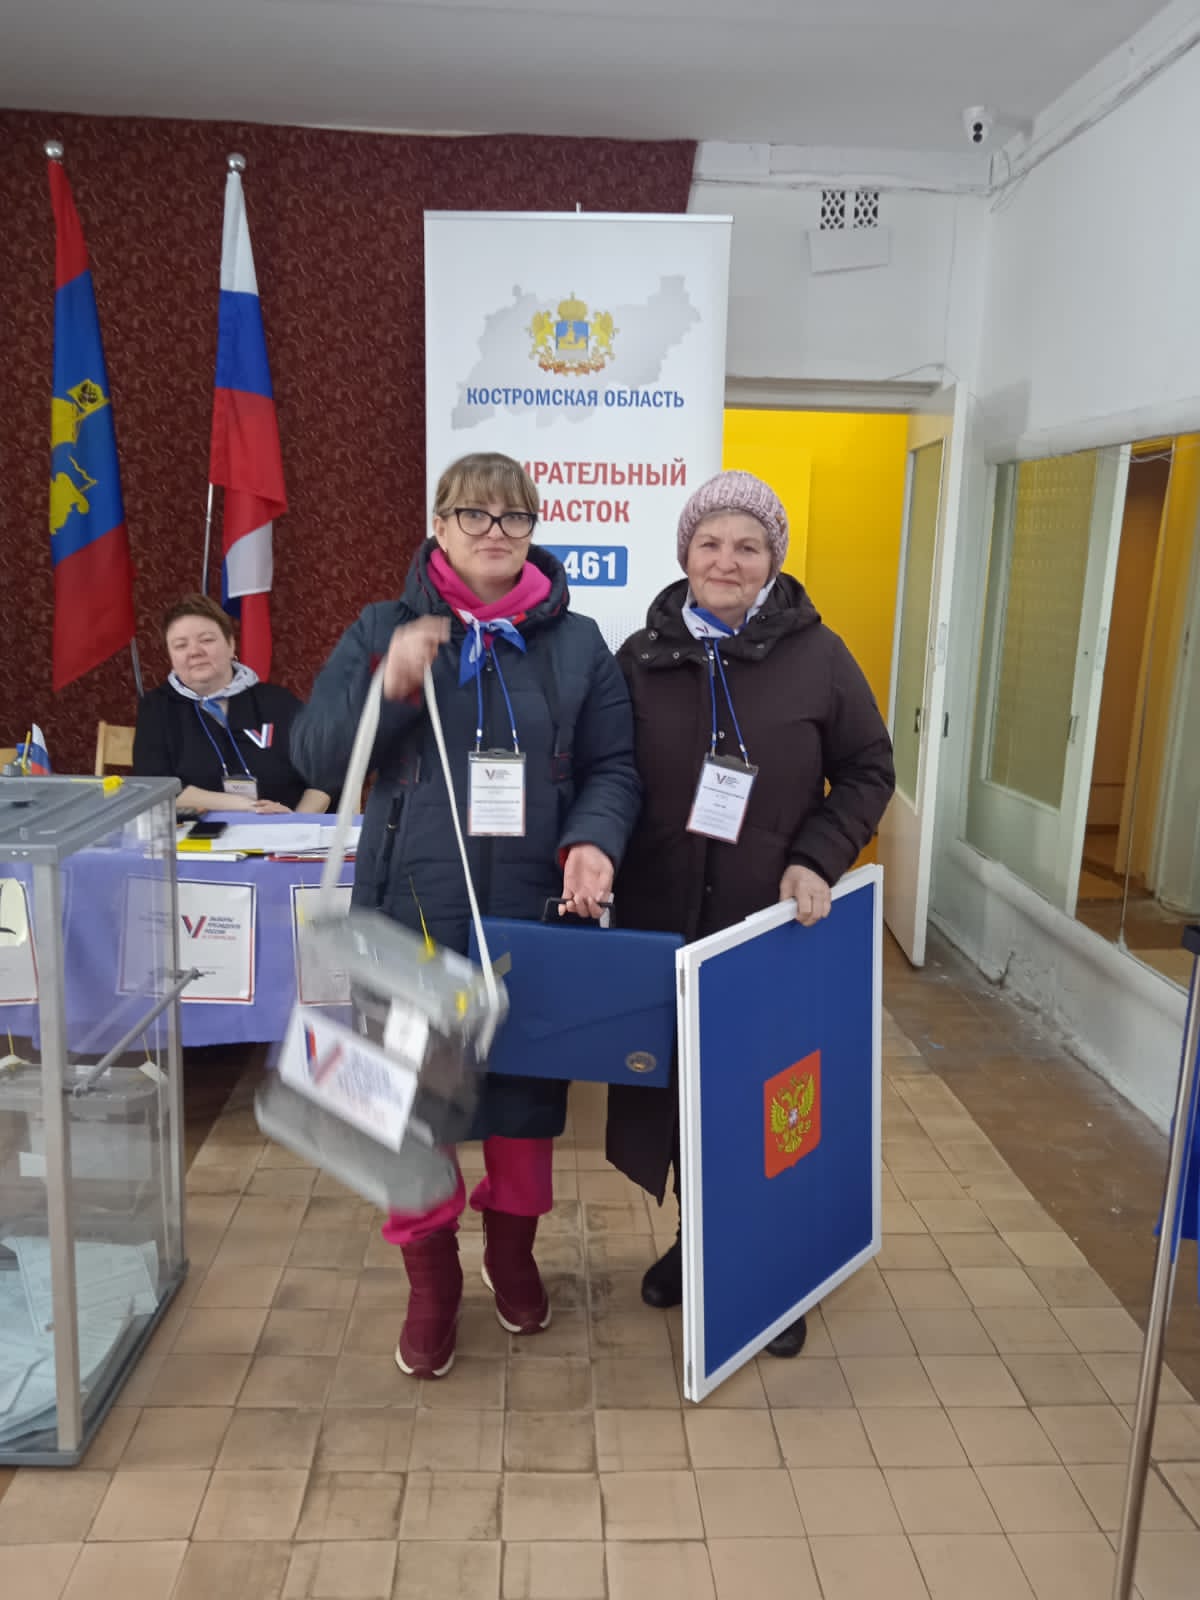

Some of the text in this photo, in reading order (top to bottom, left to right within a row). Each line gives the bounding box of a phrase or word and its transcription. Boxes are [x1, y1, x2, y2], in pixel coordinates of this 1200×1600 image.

[466, 387, 685, 408] КОСТРОМСКАЯ ОБЛАСТЬ
[537, 499, 630, 523] ЧАСТОК
